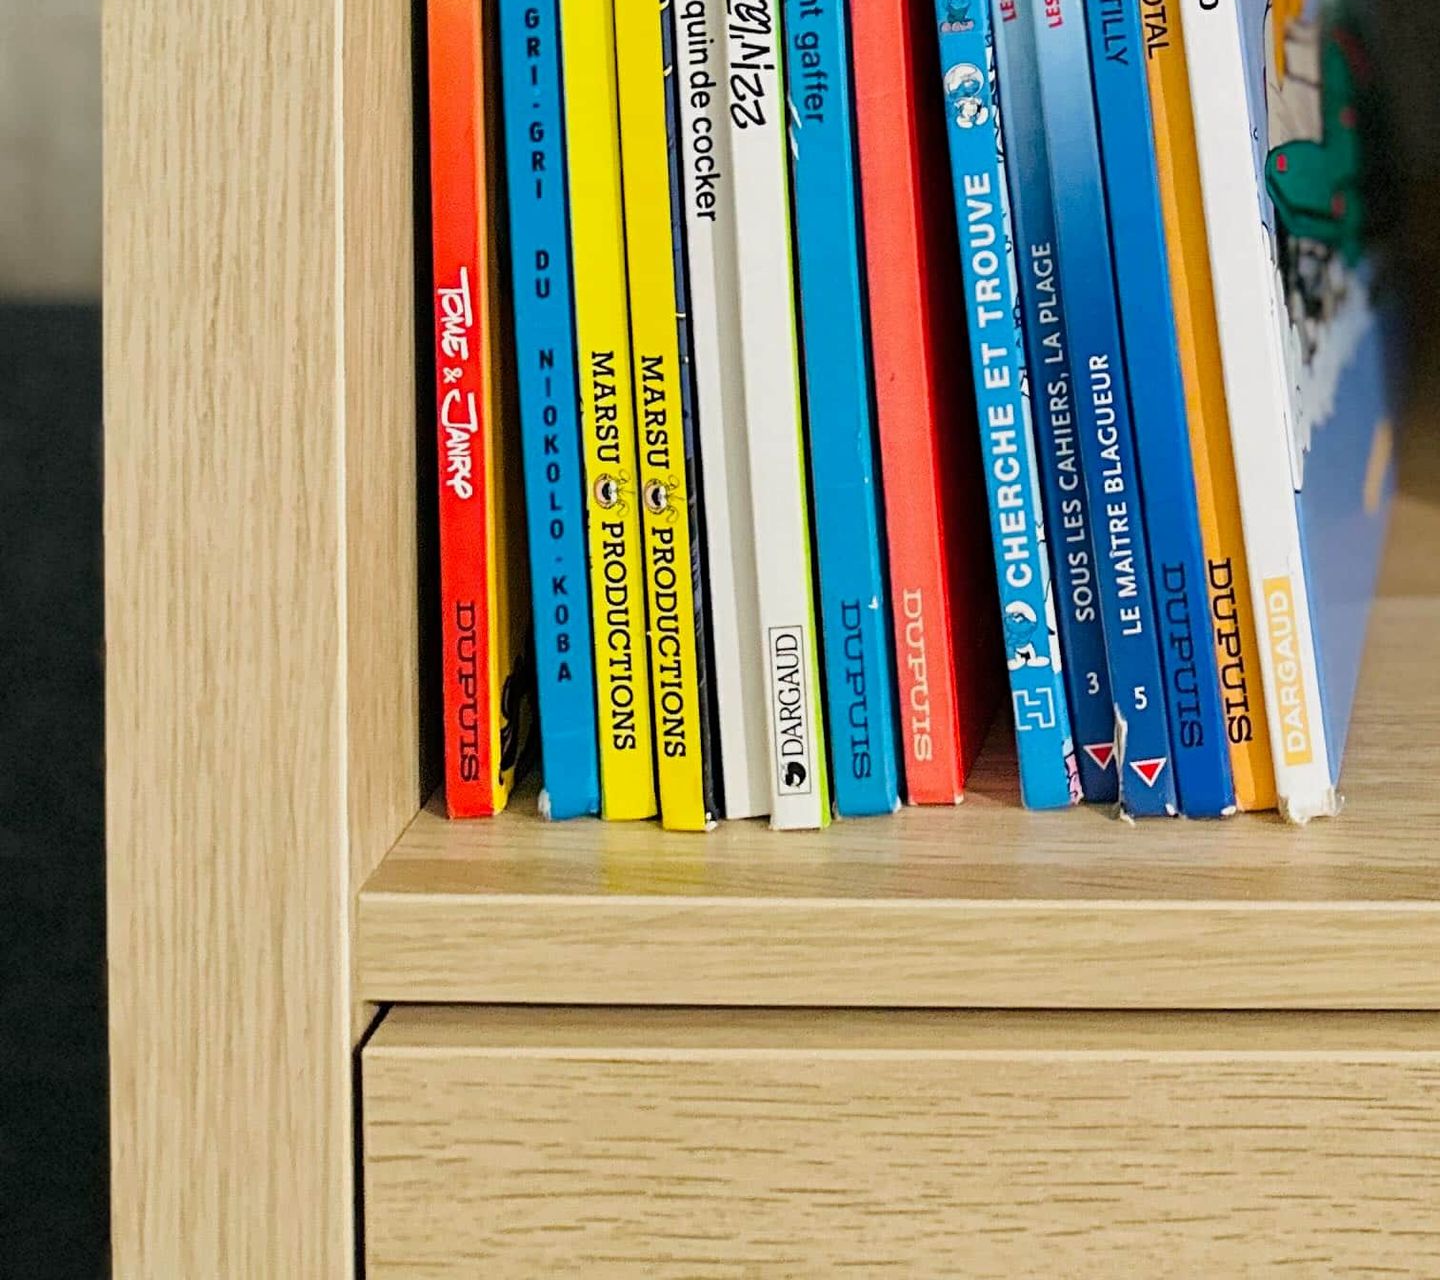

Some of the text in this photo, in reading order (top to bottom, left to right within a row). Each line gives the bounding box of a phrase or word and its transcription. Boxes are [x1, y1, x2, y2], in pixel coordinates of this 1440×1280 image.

[689, 70, 717, 109] de
[795, 30, 829, 124] gaffer
[693, 117, 721, 222] cocker
[437, 266, 473, 360] TOME
[535, 250, 550, 299] DU
[443, 368, 464, 383] &
[964, 172, 1033, 588] CHERCHE ET TROUVE
[1032, 242, 1095, 623] SOUS LES CAHIERS, LA PLAGE
[591, 351, 636, 751] MARSU PRODUCTIONS
[641, 355, 686, 758] MARSU PRODUCTIONS
[1089, 354, 1143, 636] LE MAÎTRE BLAGUEUR
[456, 600, 480, 783] DUPUIS
[775, 633, 804, 757] DARGAUD
[841, 598, 872, 780] DUPUIS
[903, 587, 933, 763] DUPUIS
[1087, 672, 1100, 694] 3
[1134, 686, 1148, 709] 5
[1162, 562, 1204, 748] DUPUIS
[1208, 557, 1253, 744] DUPUIS
[1269, 591, 1306, 753] DARGAUD
